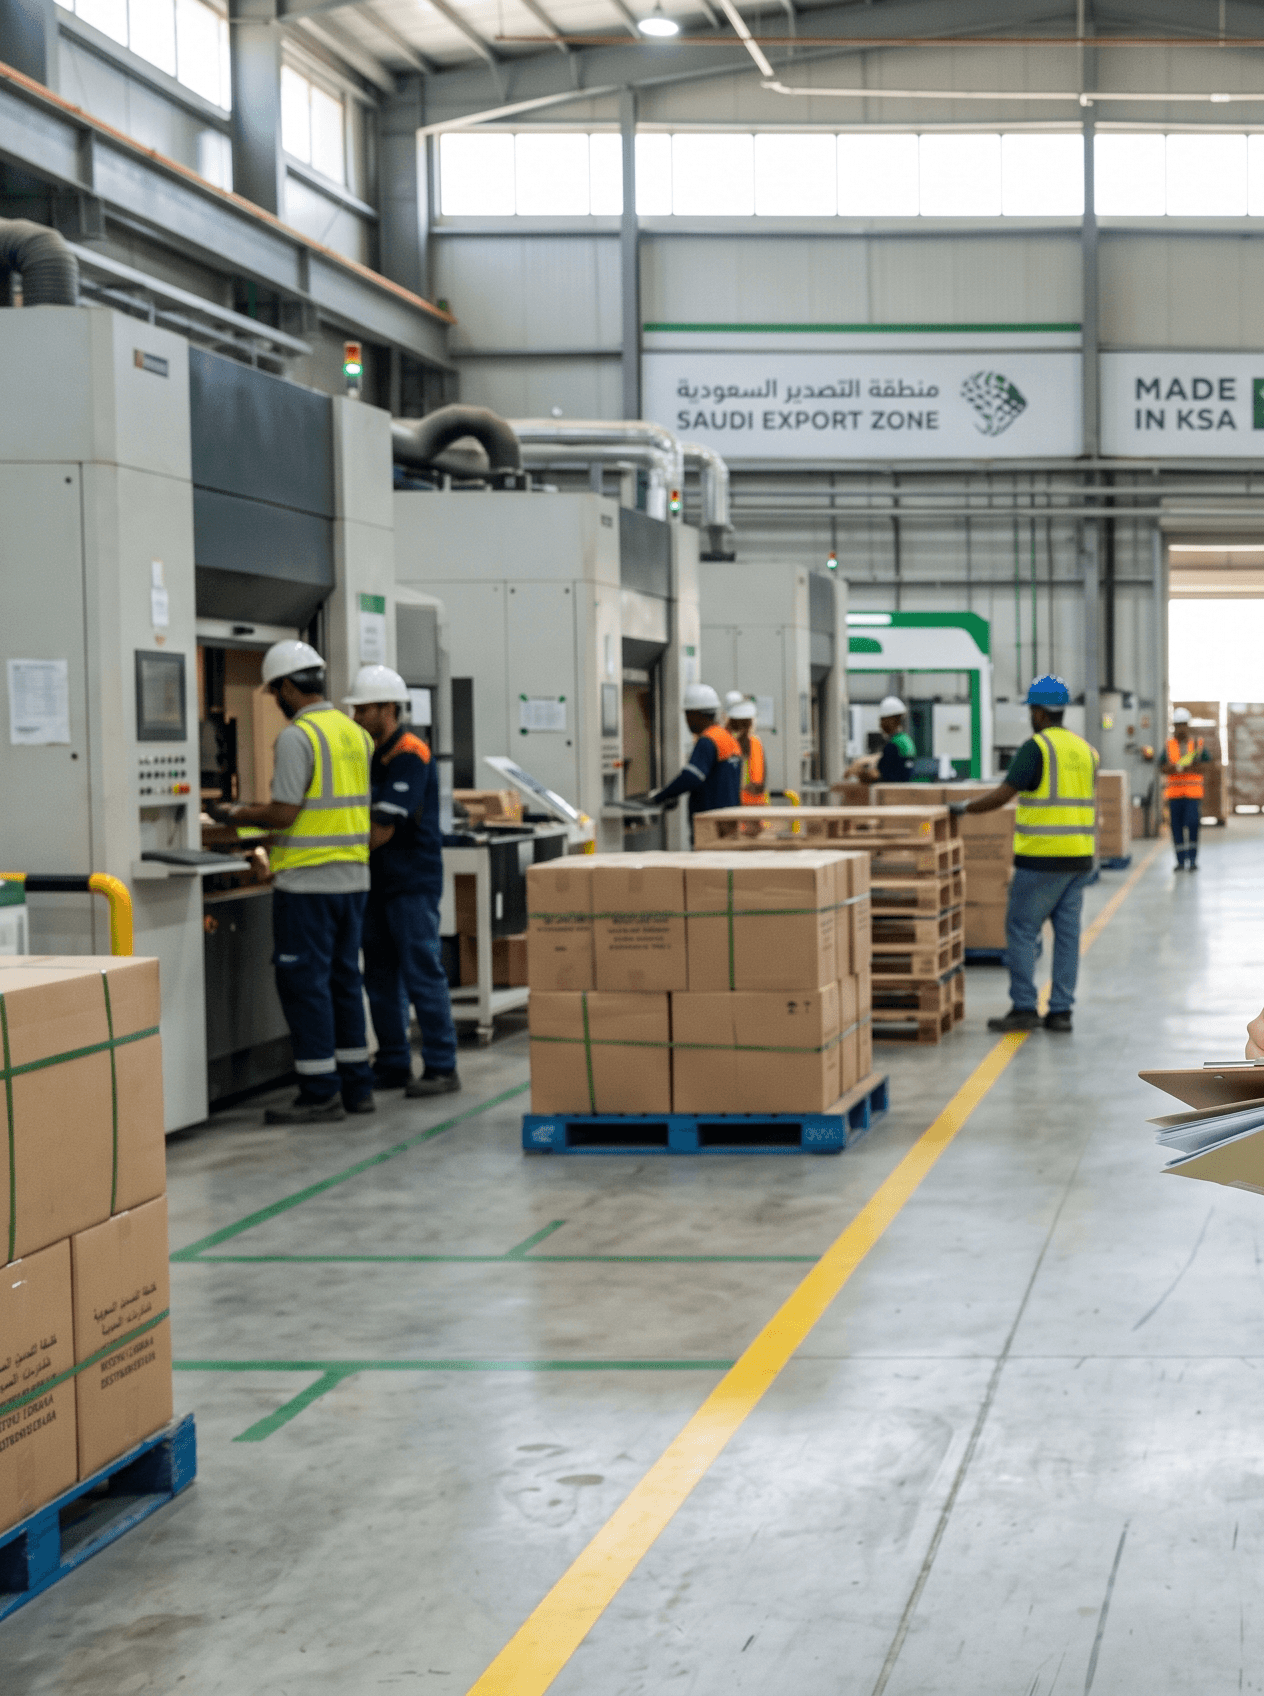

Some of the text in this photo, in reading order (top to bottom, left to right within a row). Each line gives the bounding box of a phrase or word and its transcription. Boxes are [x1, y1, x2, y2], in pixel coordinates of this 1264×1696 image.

[677, 378, 940, 405] منطقة التصدير السعودية
[1135, 376, 1237, 401] MADE
[677, 410, 940, 431] SAUDI EXPORT ZONE
[1135, 408, 1238, 431] IN KSA
